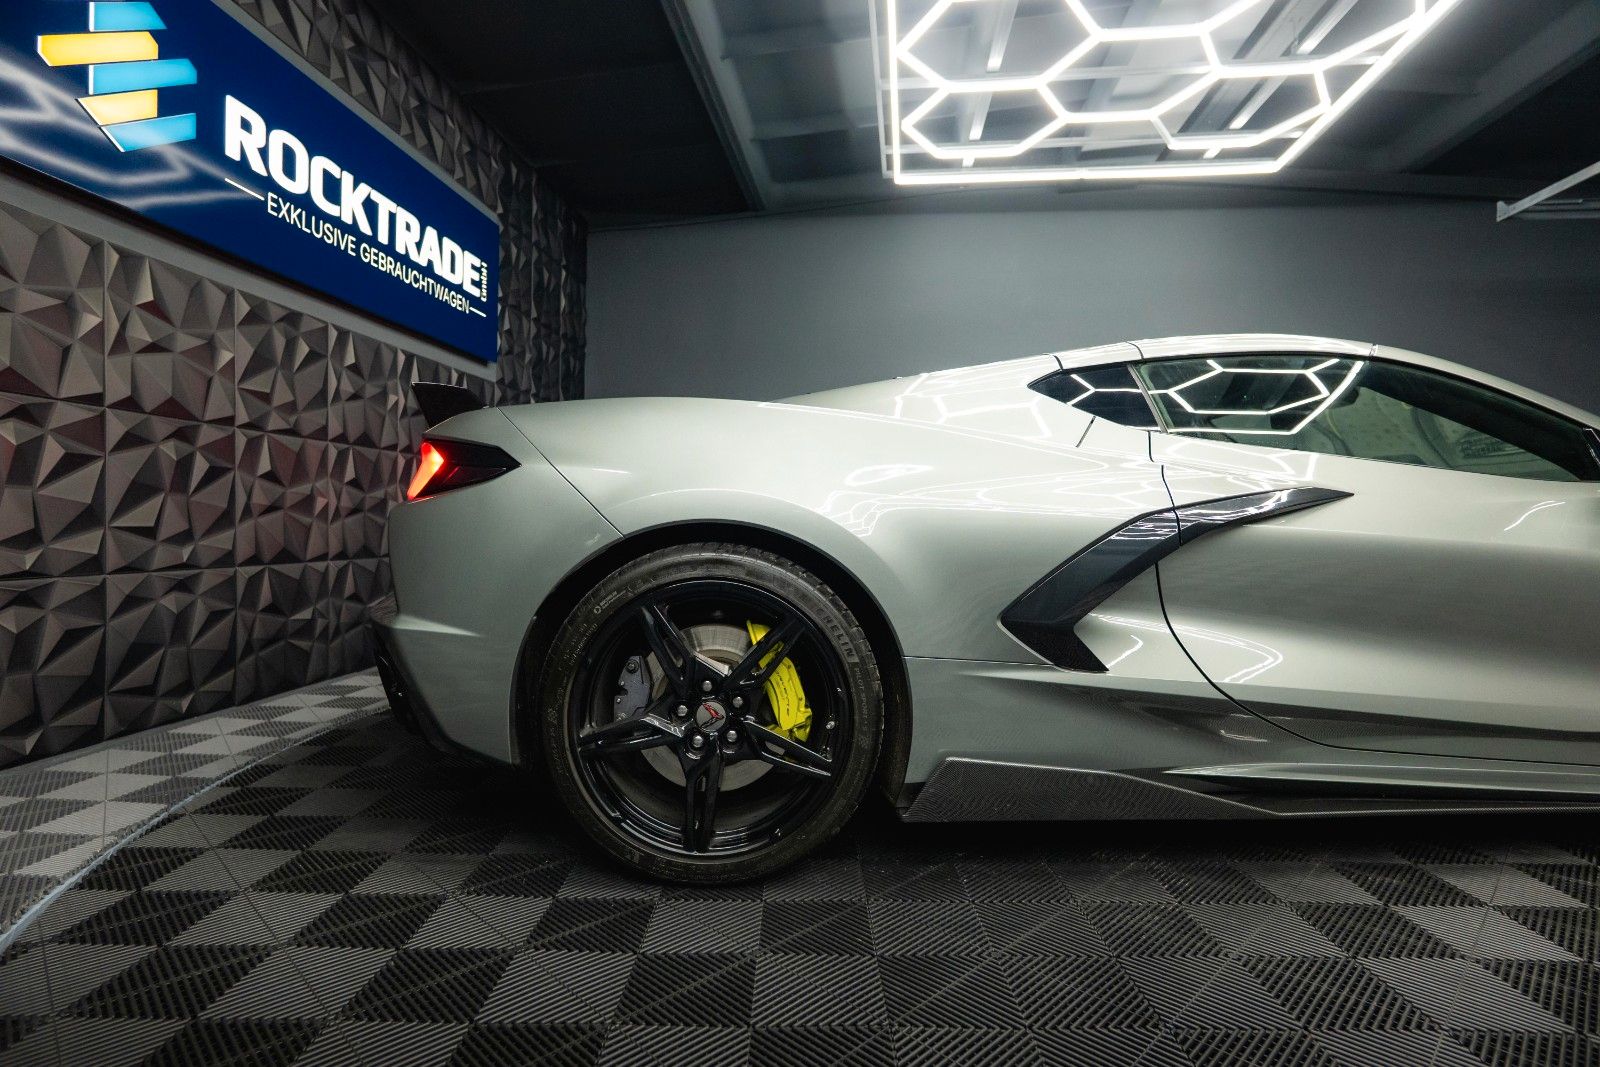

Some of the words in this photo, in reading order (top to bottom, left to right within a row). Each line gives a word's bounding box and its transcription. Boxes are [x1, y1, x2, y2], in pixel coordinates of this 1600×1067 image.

[225, 94, 481, 298] ROCKTRADE
[267, 191, 357, 257] EXKLUSIVE
[359, 242, 470, 314] GEBRAUCHTWAGEN
